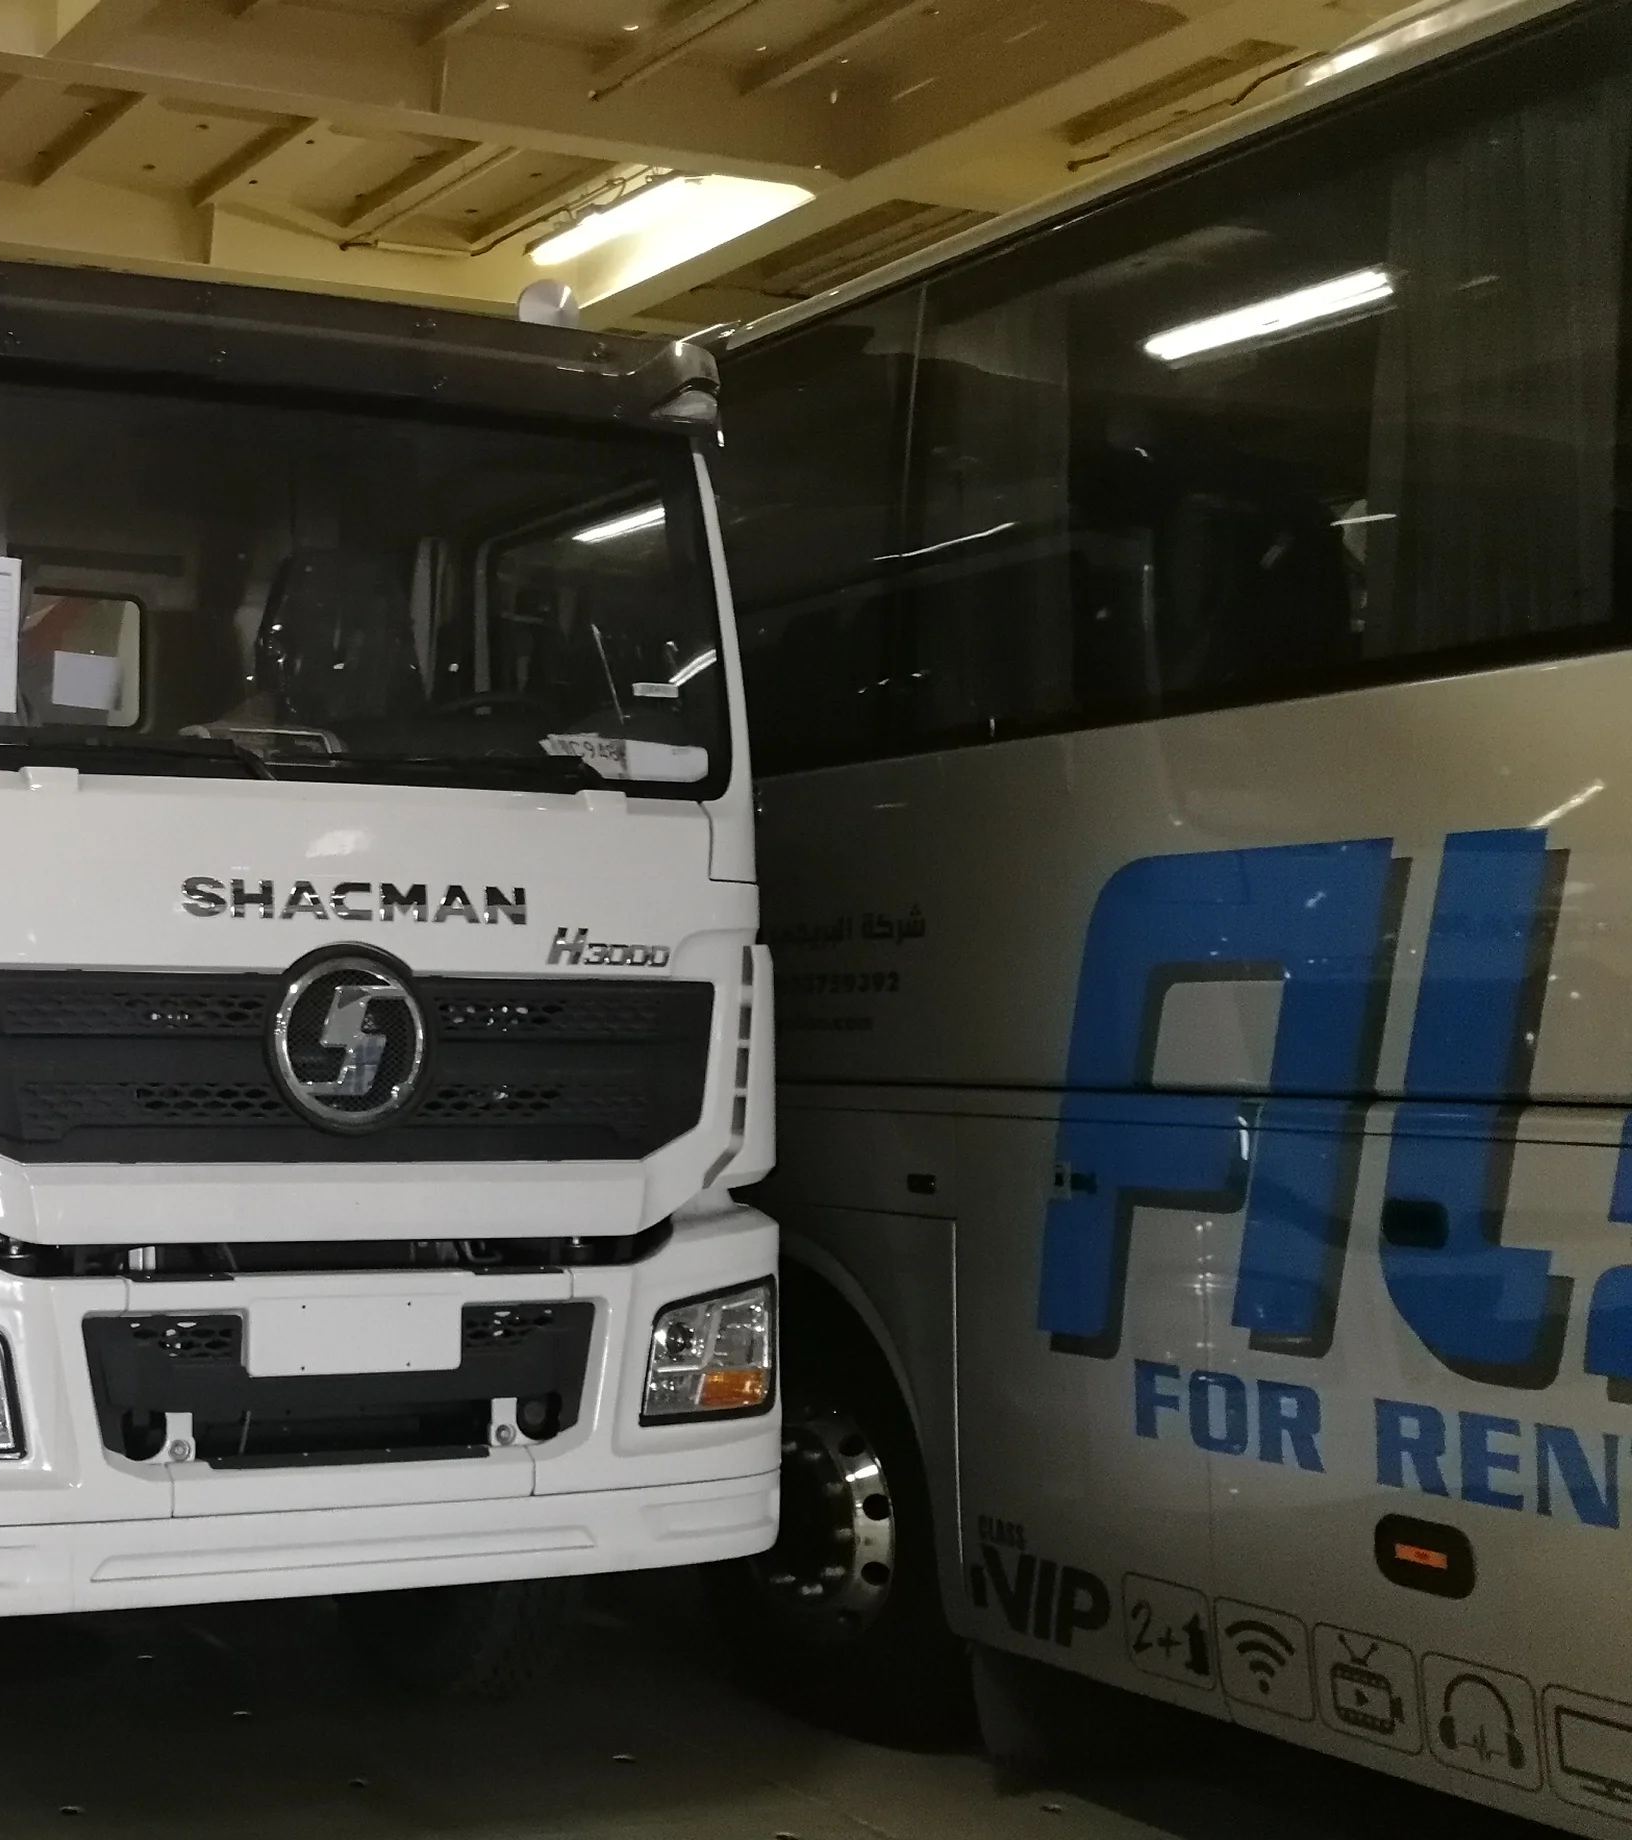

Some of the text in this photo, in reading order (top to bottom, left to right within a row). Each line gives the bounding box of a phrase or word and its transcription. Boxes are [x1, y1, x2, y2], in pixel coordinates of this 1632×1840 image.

[181, 876, 527, 925] SHACMAN
[546, 926, 671, 968] H3000
[1134, 1359, 1632, 1530] FOR REN
[977, 1514, 1028, 1550] CLASS
[969, 1543, 1111, 1648] VIP
[1131, 1599, 1210, 1676] 2+1
